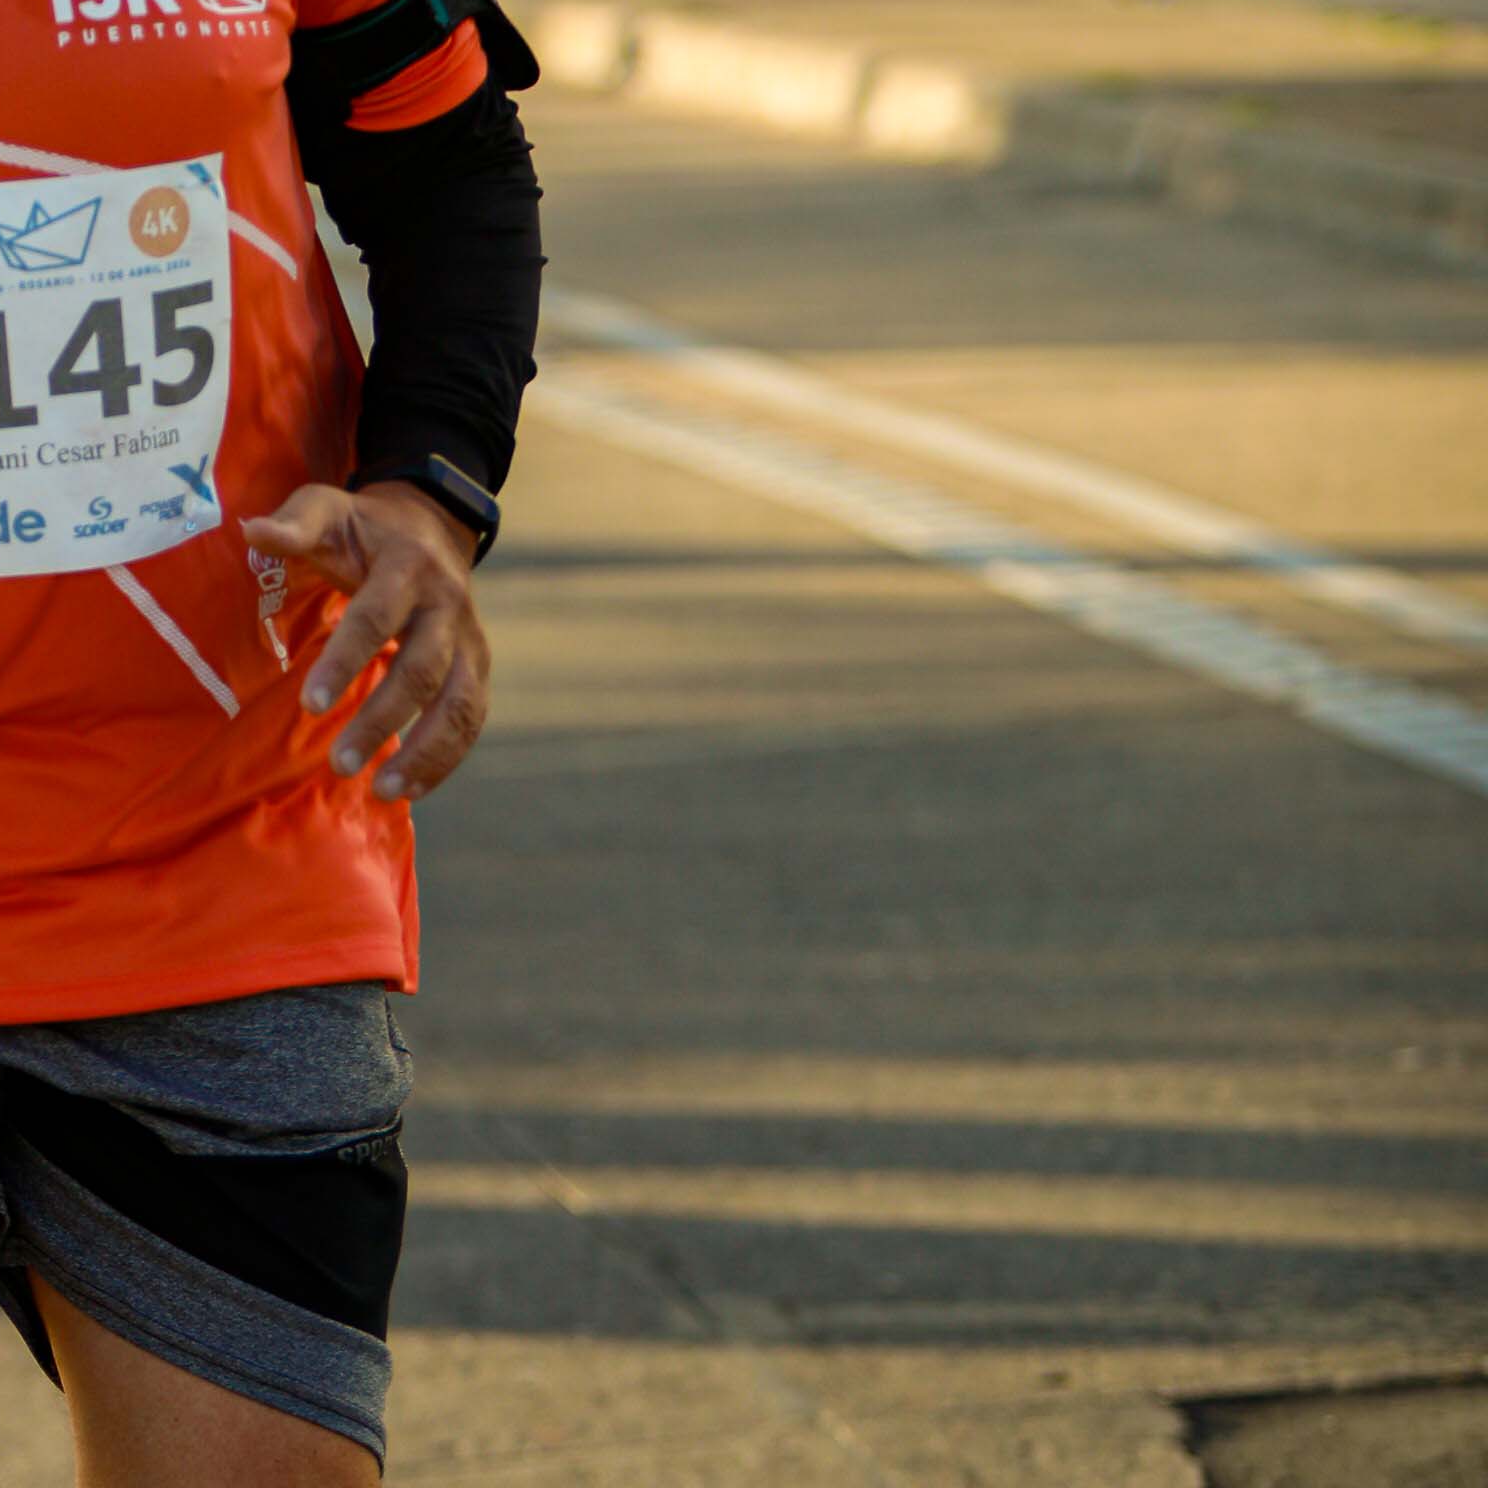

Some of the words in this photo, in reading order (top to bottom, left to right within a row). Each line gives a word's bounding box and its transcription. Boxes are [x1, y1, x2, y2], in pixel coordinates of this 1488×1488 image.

[57, 21, 188, 48] PUERTO
[199, 20, 272, 37] NORTE
[141, 206, 179, 238] 4K
[19, 276, 74, 291] ROSARIO
[108, 269, 124, 281] DE
[128, 265, 161, 278] ABRIL
[36, 441, 105, 467] Cesar
[113, 426, 180, 458] Fabian
